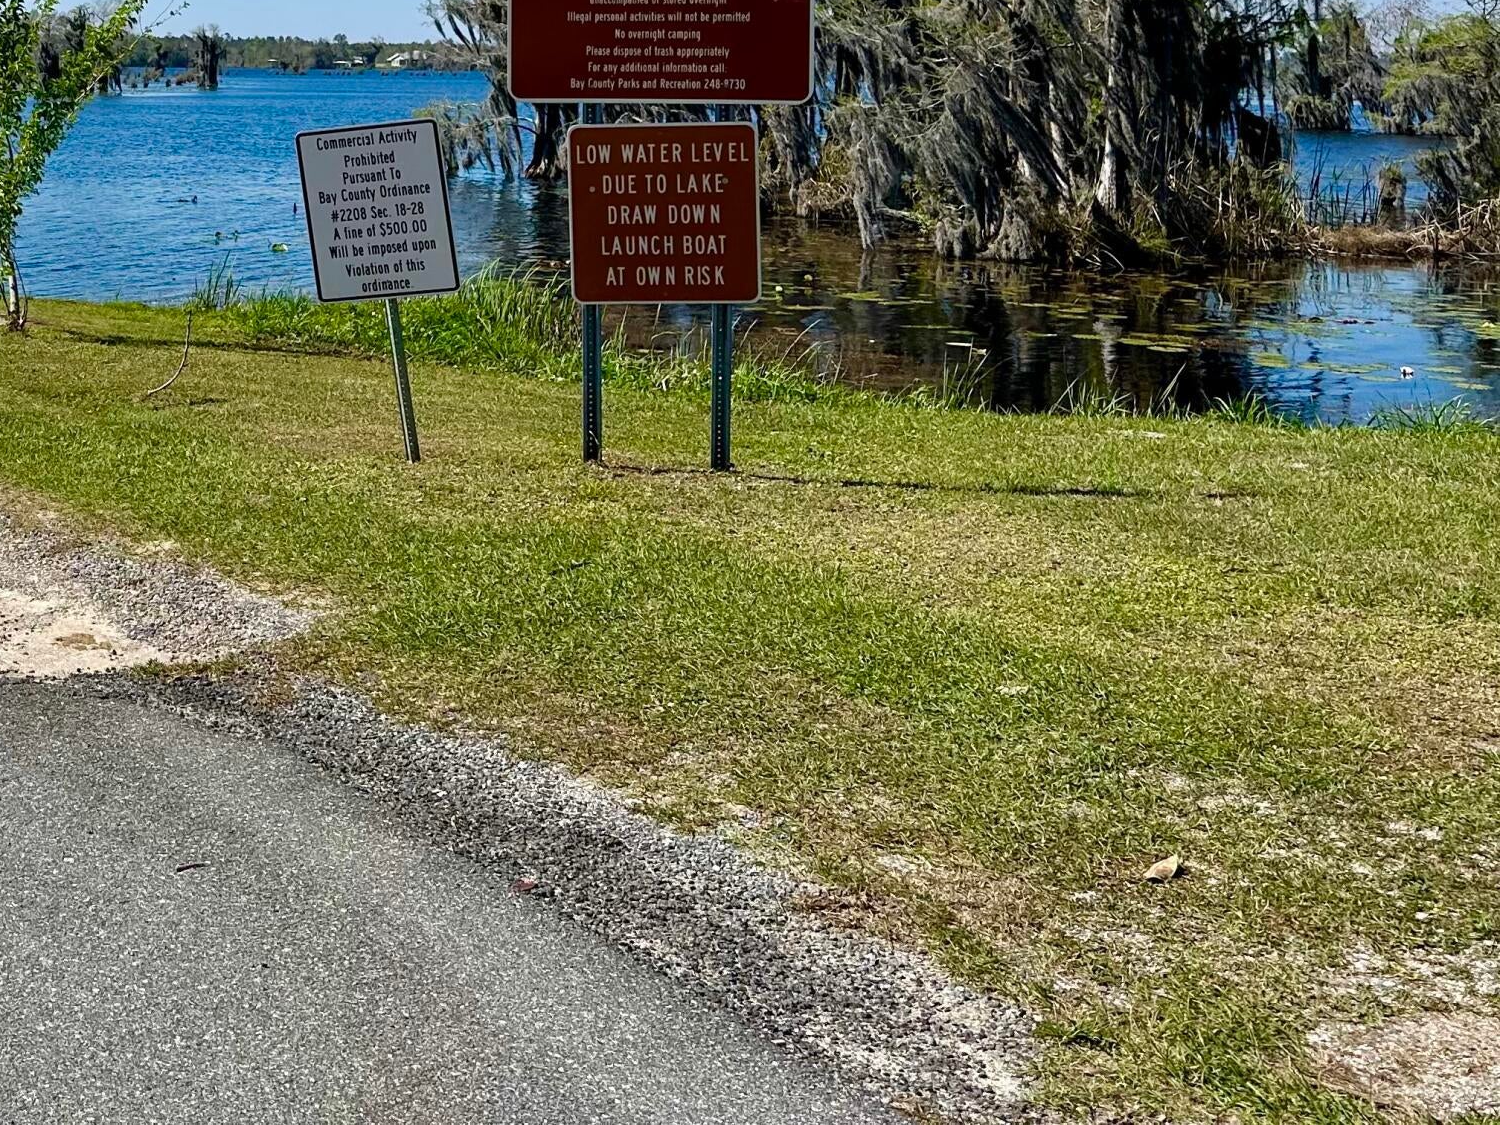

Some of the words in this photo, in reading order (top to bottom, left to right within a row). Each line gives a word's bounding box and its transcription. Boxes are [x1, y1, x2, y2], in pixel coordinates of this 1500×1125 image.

[567, 11, 592, 24] Illegal
[594, 12, 628, 23] personal
[629, 12, 665, 21] activities
[667, 12, 683, 21] will
[684, 12, 698, 21] not
[700, 12, 710, 21] be
[712, 12, 751, 24] permitted
[614, 29, 626, 38] No
[628, 29, 666, 42] overnight
[668, 31, 701, 42] camping
[586, 46, 611, 56] Please
[613, 46, 642, 58] dispose
[644, 46, 653, 56] of
[654, 46, 675, 56] trash
[676, 47, 730, 59] appropriately
[587, 62, 601, 72] For
[603, 64, 619, 74] any
[620, 62, 660, 72] additional
[662, 62, 708, 72] information
[570, 78, 585, 90] Bay
[587, 78, 615, 91] County
[618, 78, 641, 88] Parks
[642, 79, 657, 88] and
[660, 79, 701, 89] Recreation
[316, 132, 375, 151] Commercial
[378, 129, 417, 145] Activity
[343, 150, 395, 168] Prohibited
[576, 144, 611, 164] LOW
[621, 143, 682, 164] WATER
[691, 142, 750, 163] LEVEL
[343, 168, 387, 185] Pursuant
[389, 168, 402, 180] To
[602, 175, 637, 195] DUE
[645, 174, 667, 194] TO
[676, 173, 724, 193] LAKE
[318, 191, 337, 206] Bay
[341, 186, 376, 202] County
[379, 182, 431, 198] Ordinance
[330, 207, 367, 223] #2208
[370, 205, 392, 219] Sec.
[395, 201, 425, 216] 18-28
[607, 205, 657, 225] DRAW
[668, 204, 721, 224] DOWN
[333, 228, 341, 241] A
[343, 226, 363, 239] fine
[366, 224, 376, 237] of
[380, 219, 428, 237] $500.00
[329, 246, 349, 259] Will
[352, 244, 364, 257] be
[367, 240, 408, 257] imposed
[411, 238, 437, 252] upon
[601, 235, 674, 256] LAUNCH
[683, 235, 727, 255] BOAT
[345, 262, 390, 278] Violation
[393, 260, 403, 274] of
[406, 259, 426, 273] this
[606, 267, 626, 286] AT
[636, 266, 676, 286] OWN
[684, 265, 725, 286] RISK
